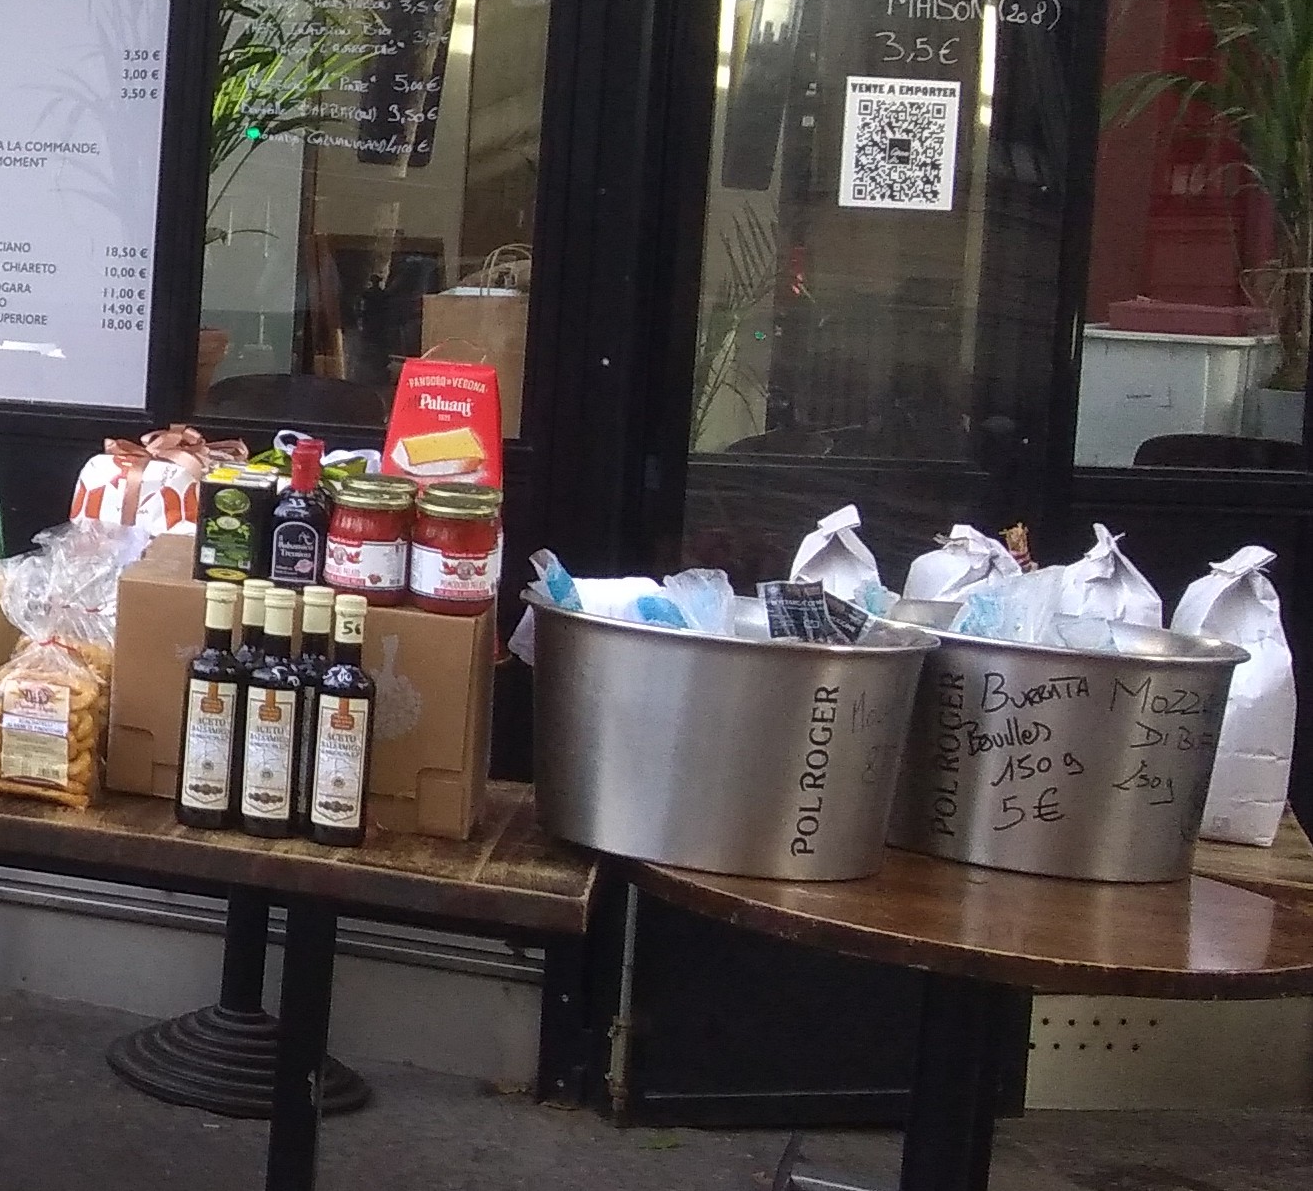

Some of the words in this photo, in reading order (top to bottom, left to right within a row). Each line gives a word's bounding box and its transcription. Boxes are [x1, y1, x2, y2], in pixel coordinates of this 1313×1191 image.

[123, 69, 147, 80] 3,00
[151, 70, 158, 80] €
[121, 88, 146, 99] 3,50
[149, 88, 157, 99] €
[851, 82, 885, 94] VENTE
[887, 84, 896, 95] A
[899, 85, 956, 98] EMPORTER
[7, 142, 22, 151] LA
[25, 142, 100, 155] COMMANDE,
[3, 261, 56, 274] CHIARETO
[452, 377, 486, 393] VERONA
[418, 393, 472, 418] Paluani
[980, 672, 1089, 713] BURRATA
[939, 672, 964, 773] ROGER
[799, 685, 840, 792] ROGER
[990, 755, 1052, 787] 150
[933, 779, 959, 837] POL
[993, 796, 1025, 831] 5
[1033, 787, 1065, 822] €
[791, 796, 823, 858] POL
